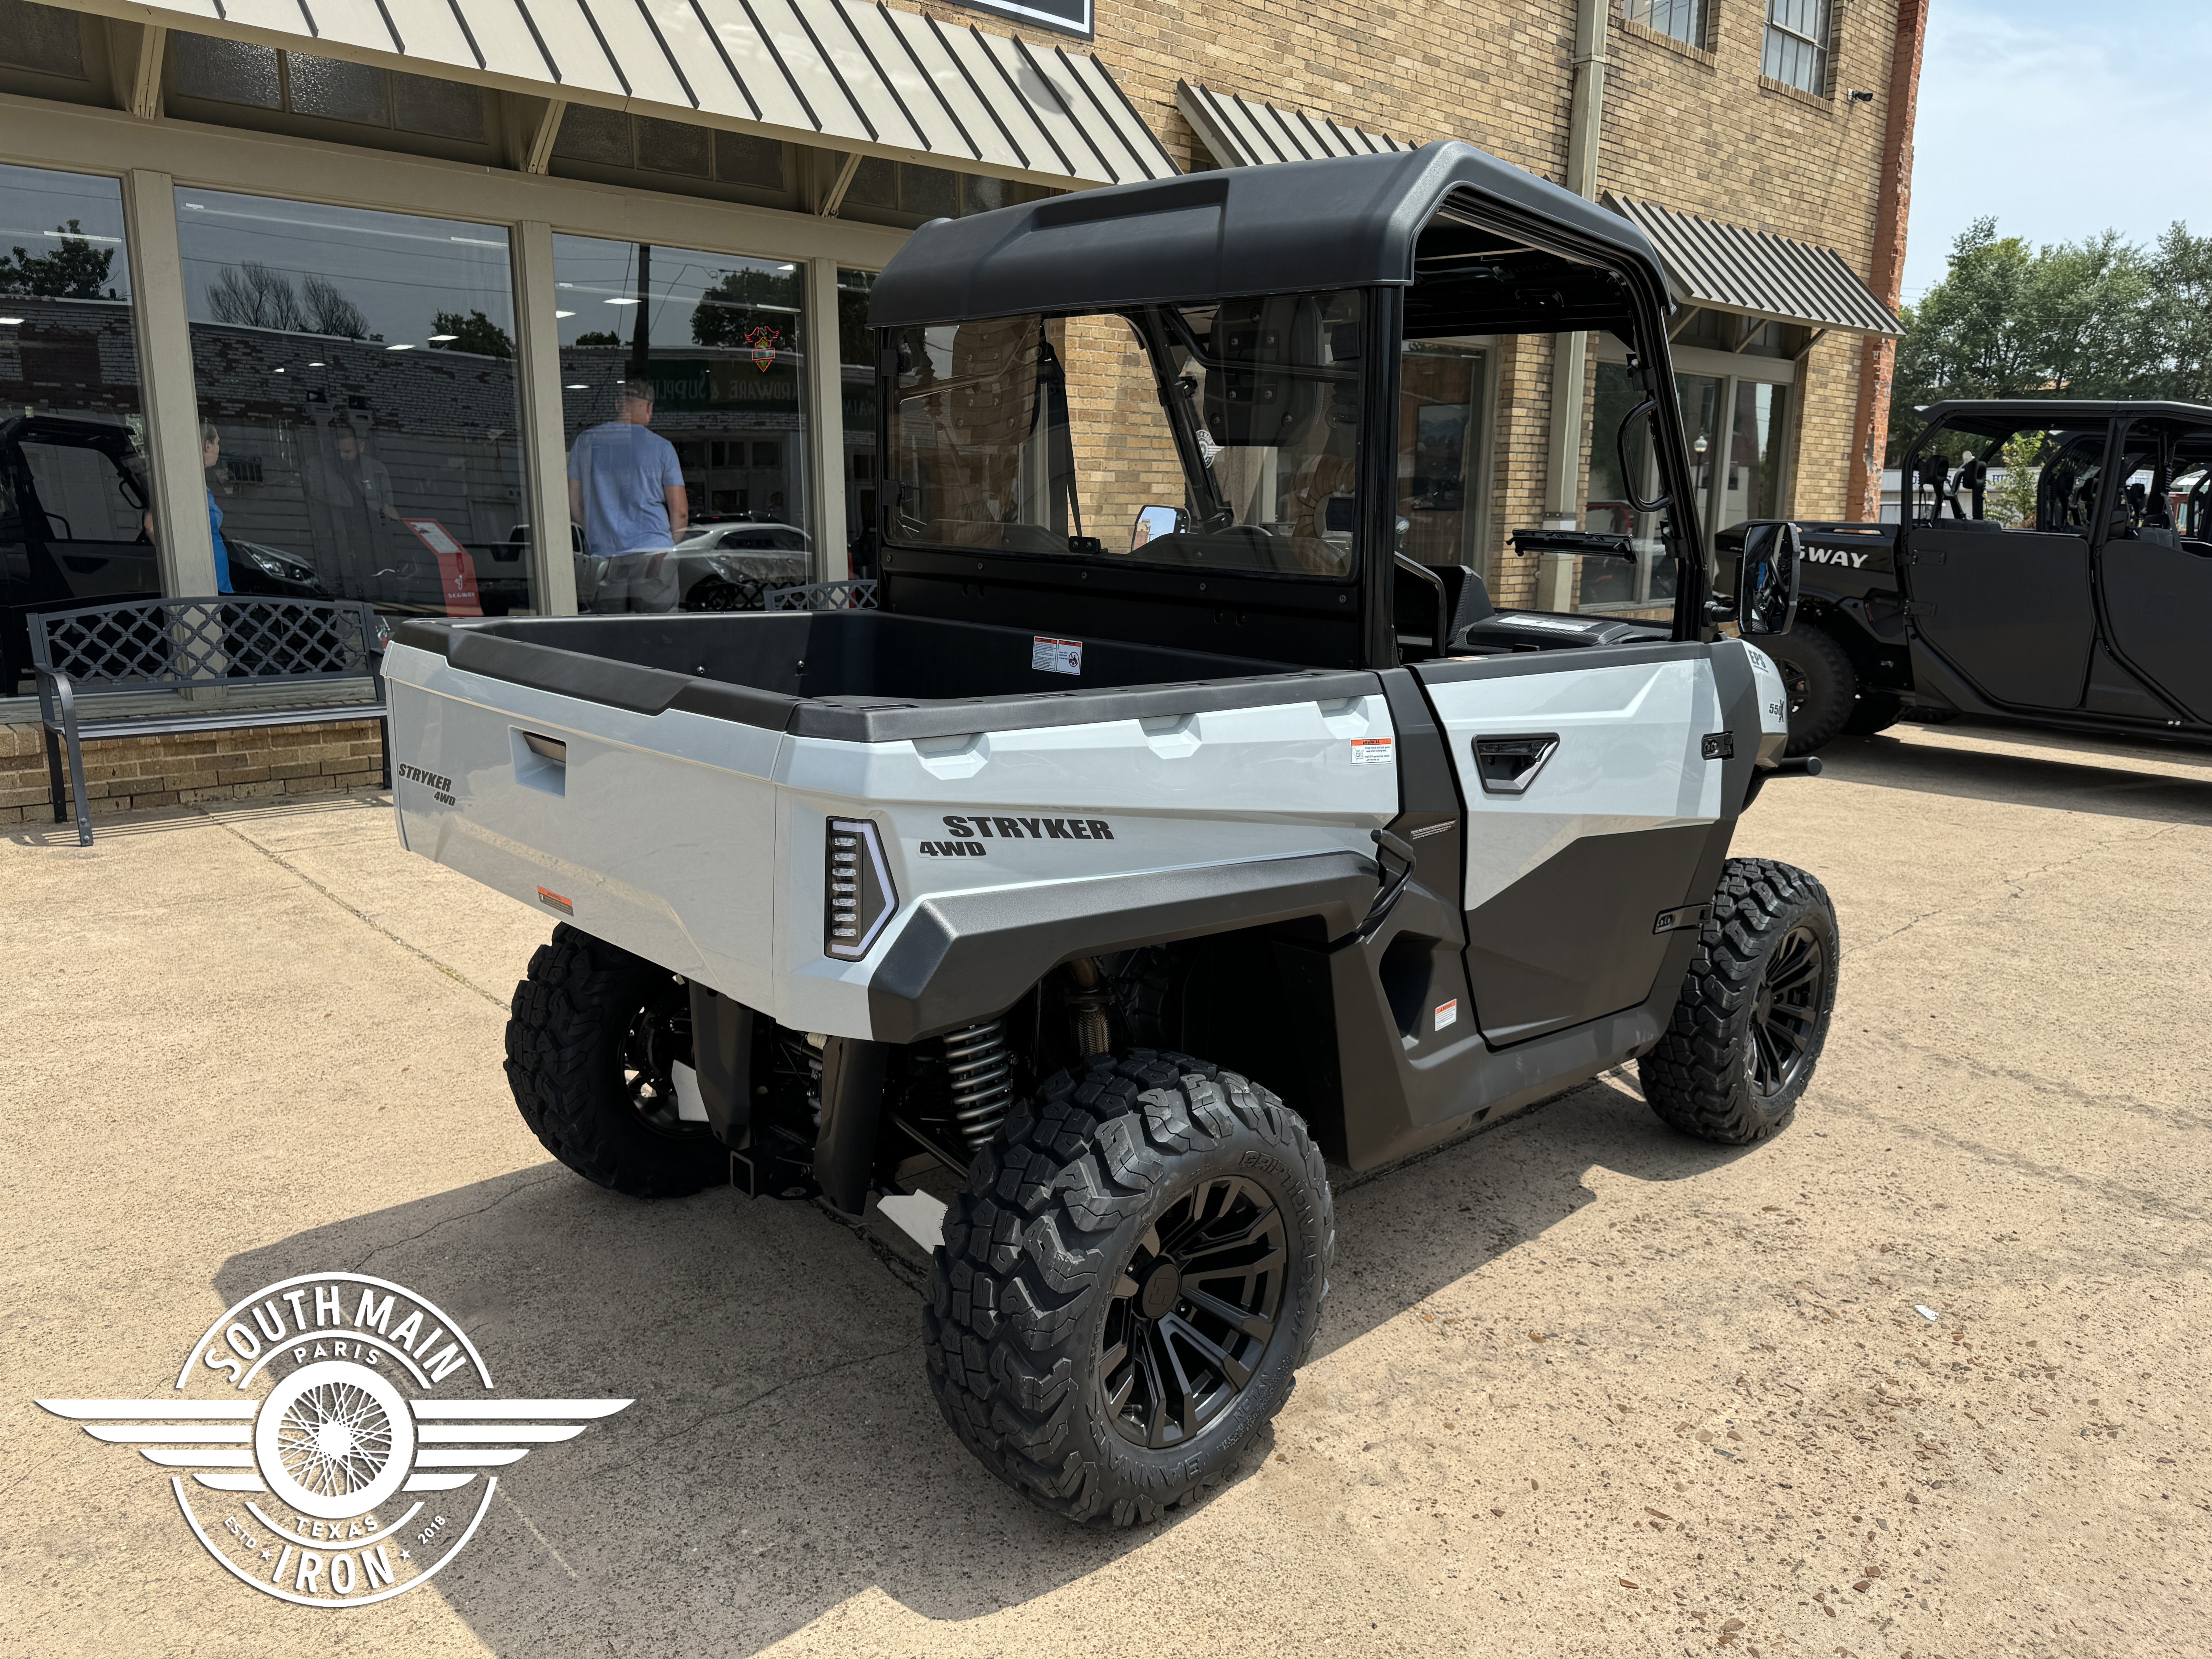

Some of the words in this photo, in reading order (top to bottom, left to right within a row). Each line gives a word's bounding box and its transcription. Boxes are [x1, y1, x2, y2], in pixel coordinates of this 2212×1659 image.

[1747, 649, 1766, 669] EPS
[399, 763, 452, 792] STRYKER
[434, 791, 456, 806] 4WD
[942, 816, 1114, 840] STRYKER
[920, 841, 987, 857] 4WD
